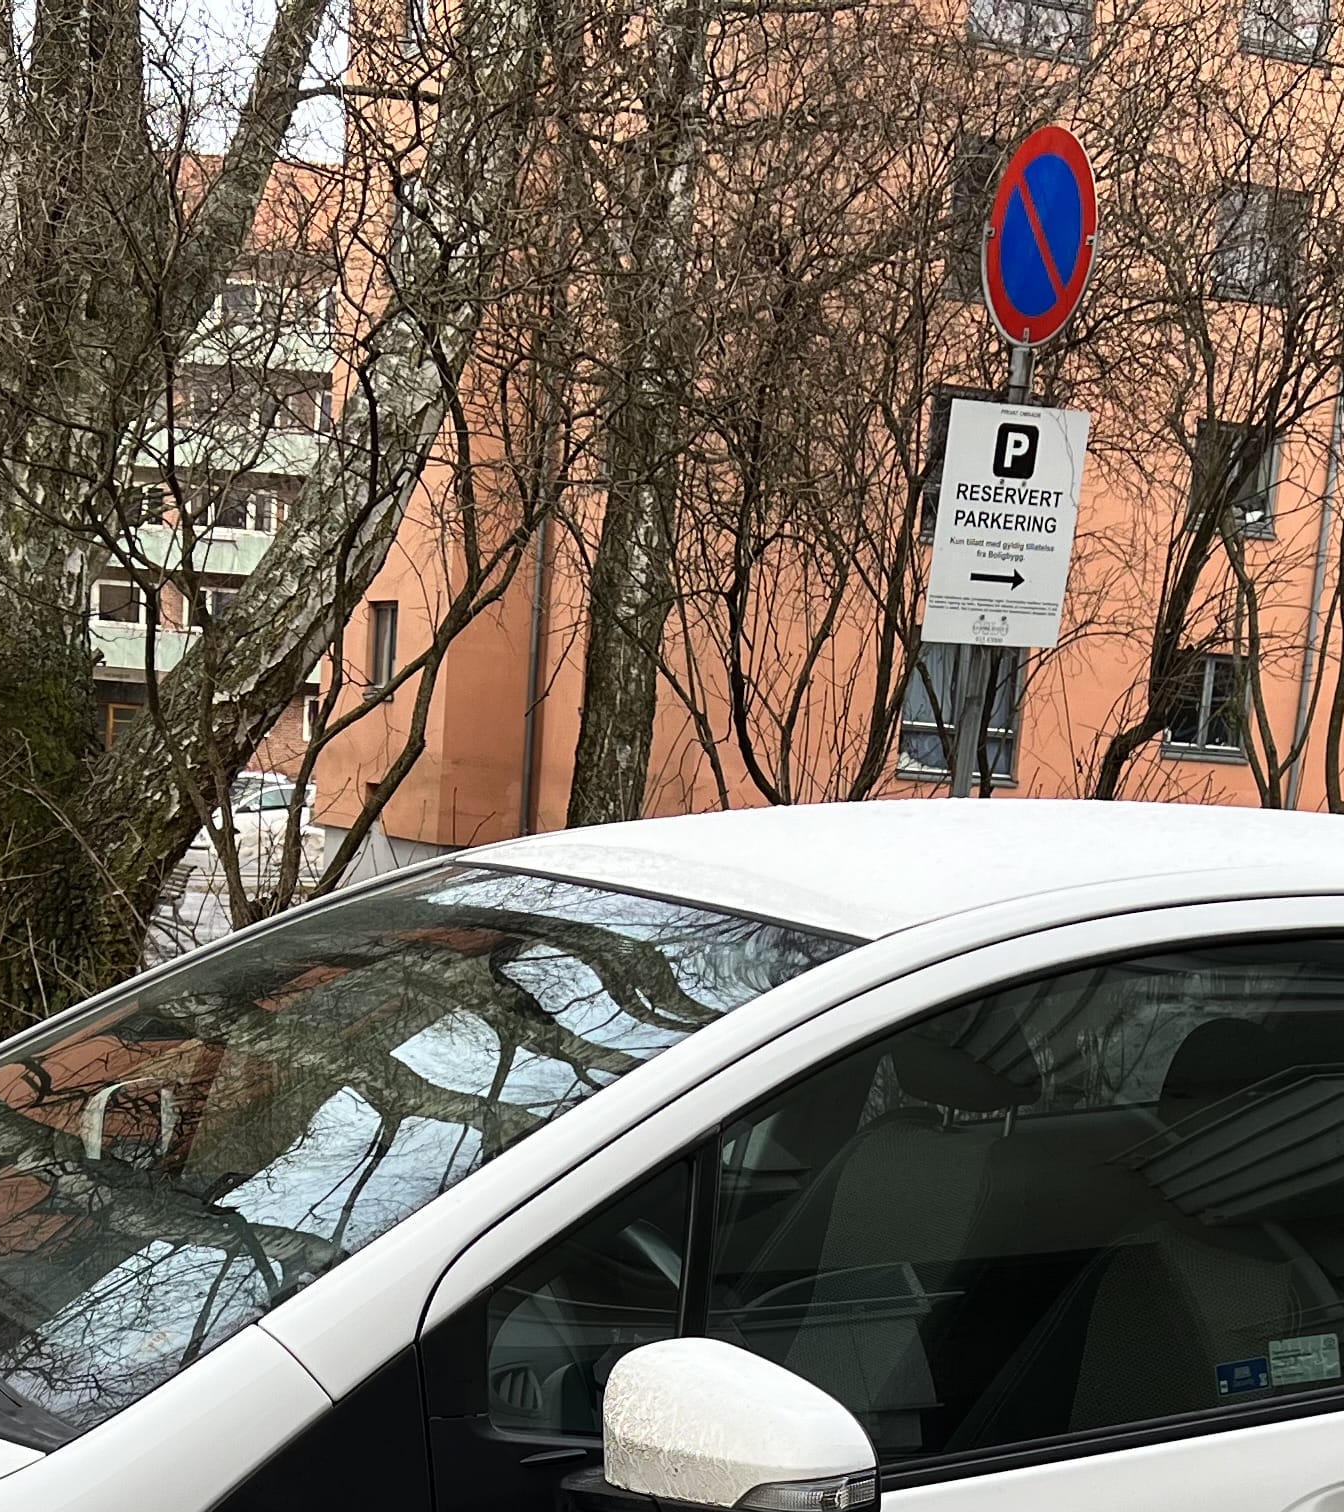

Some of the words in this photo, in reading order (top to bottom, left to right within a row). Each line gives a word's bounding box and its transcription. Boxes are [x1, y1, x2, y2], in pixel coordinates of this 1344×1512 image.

[1003, 432, 1030, 468] P
[956, 483, 1063, 508] RESERVERT
[954, 509, 1057, 534] PARKERING
[949, 537, 965, 545] Kun
[986, 540, 1001, 548] med
[1002, 542, 1025, 551] gyldig
[976, 550, 986, 558] fra
